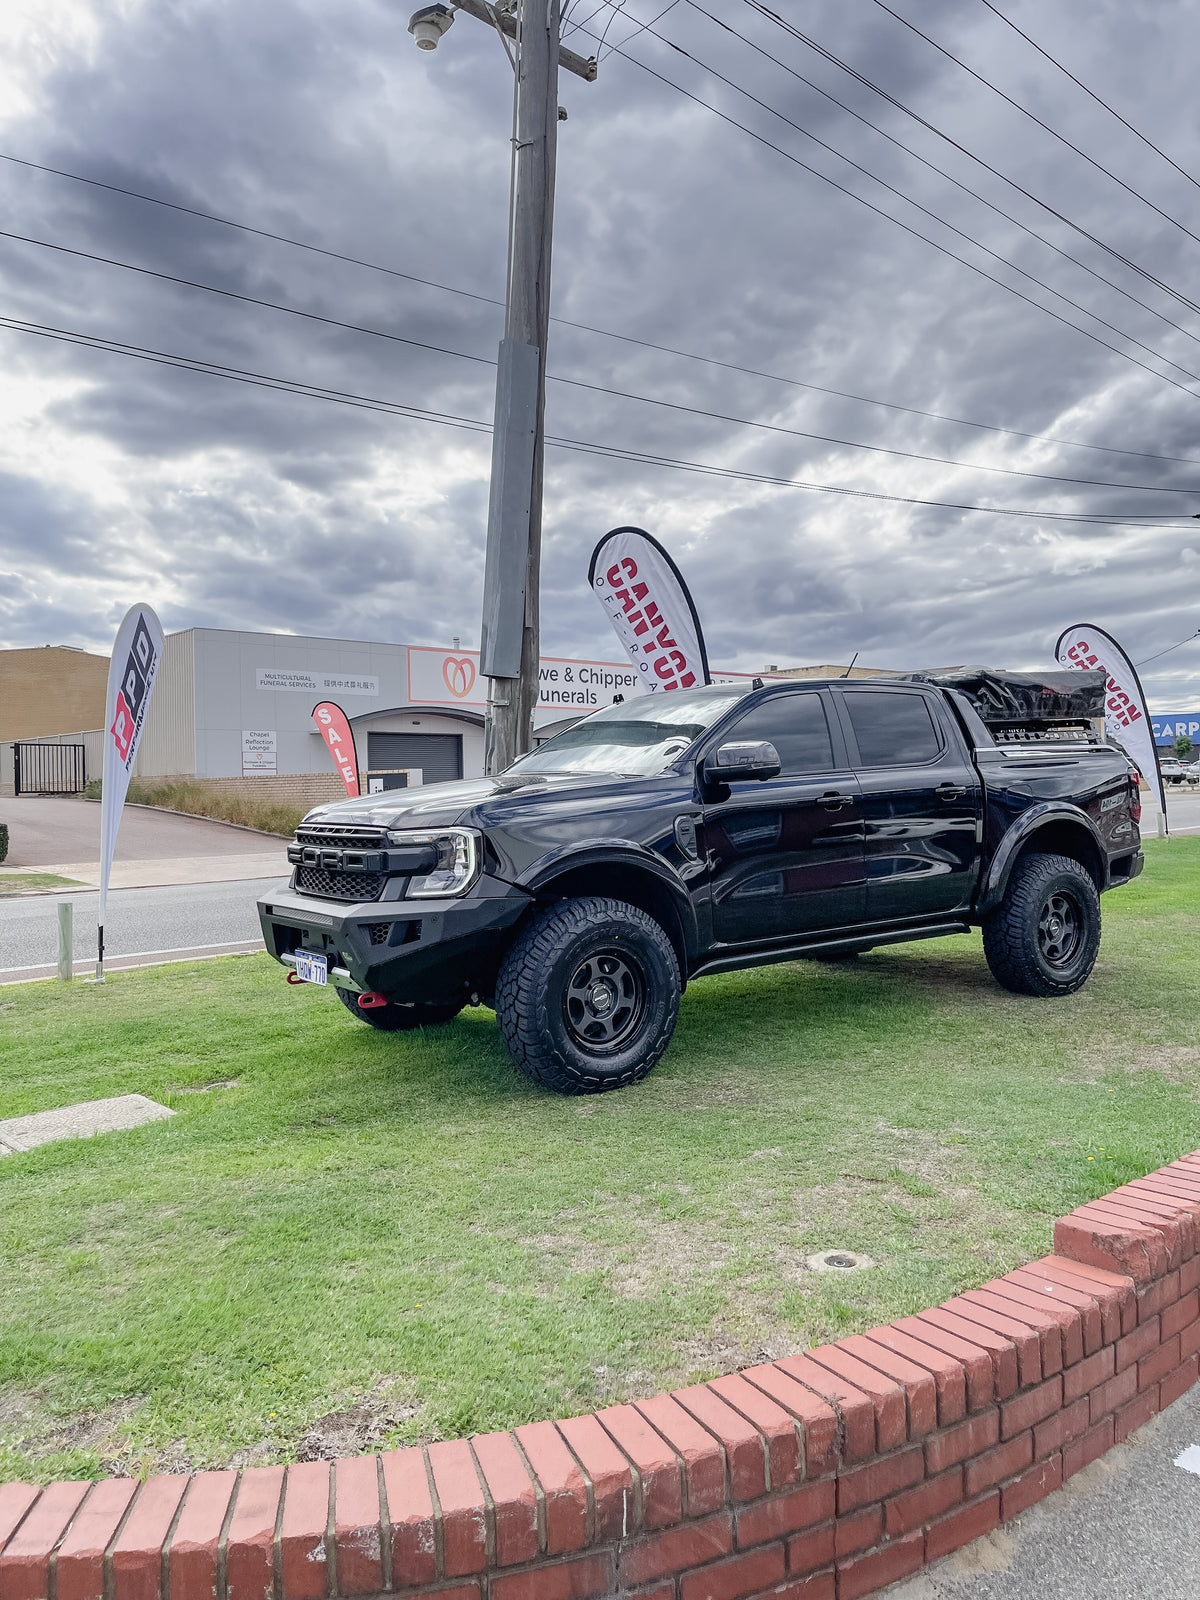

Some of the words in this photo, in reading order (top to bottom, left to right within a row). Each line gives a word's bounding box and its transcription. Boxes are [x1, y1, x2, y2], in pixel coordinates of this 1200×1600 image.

[595, 576, 658, 692] OFF-ROA
[606, 557, 697, 691] CANYON
[260, 680, 287, 688] FUNERAL
[288, 681, 316, 689] SERVICES
[264, 673, 311, 682] MULTICULTURAL
[538, 668, 558, 681] we
[564, 667, 574, 682] &
[578, 668, 638, 689] Chipper
[1067, 641, 1143, 728] CAYON
[540, 689, 597, 704] unerals
[1151, 721, 1200, 738] CARP
[317, 708, 355, 783] SALE
